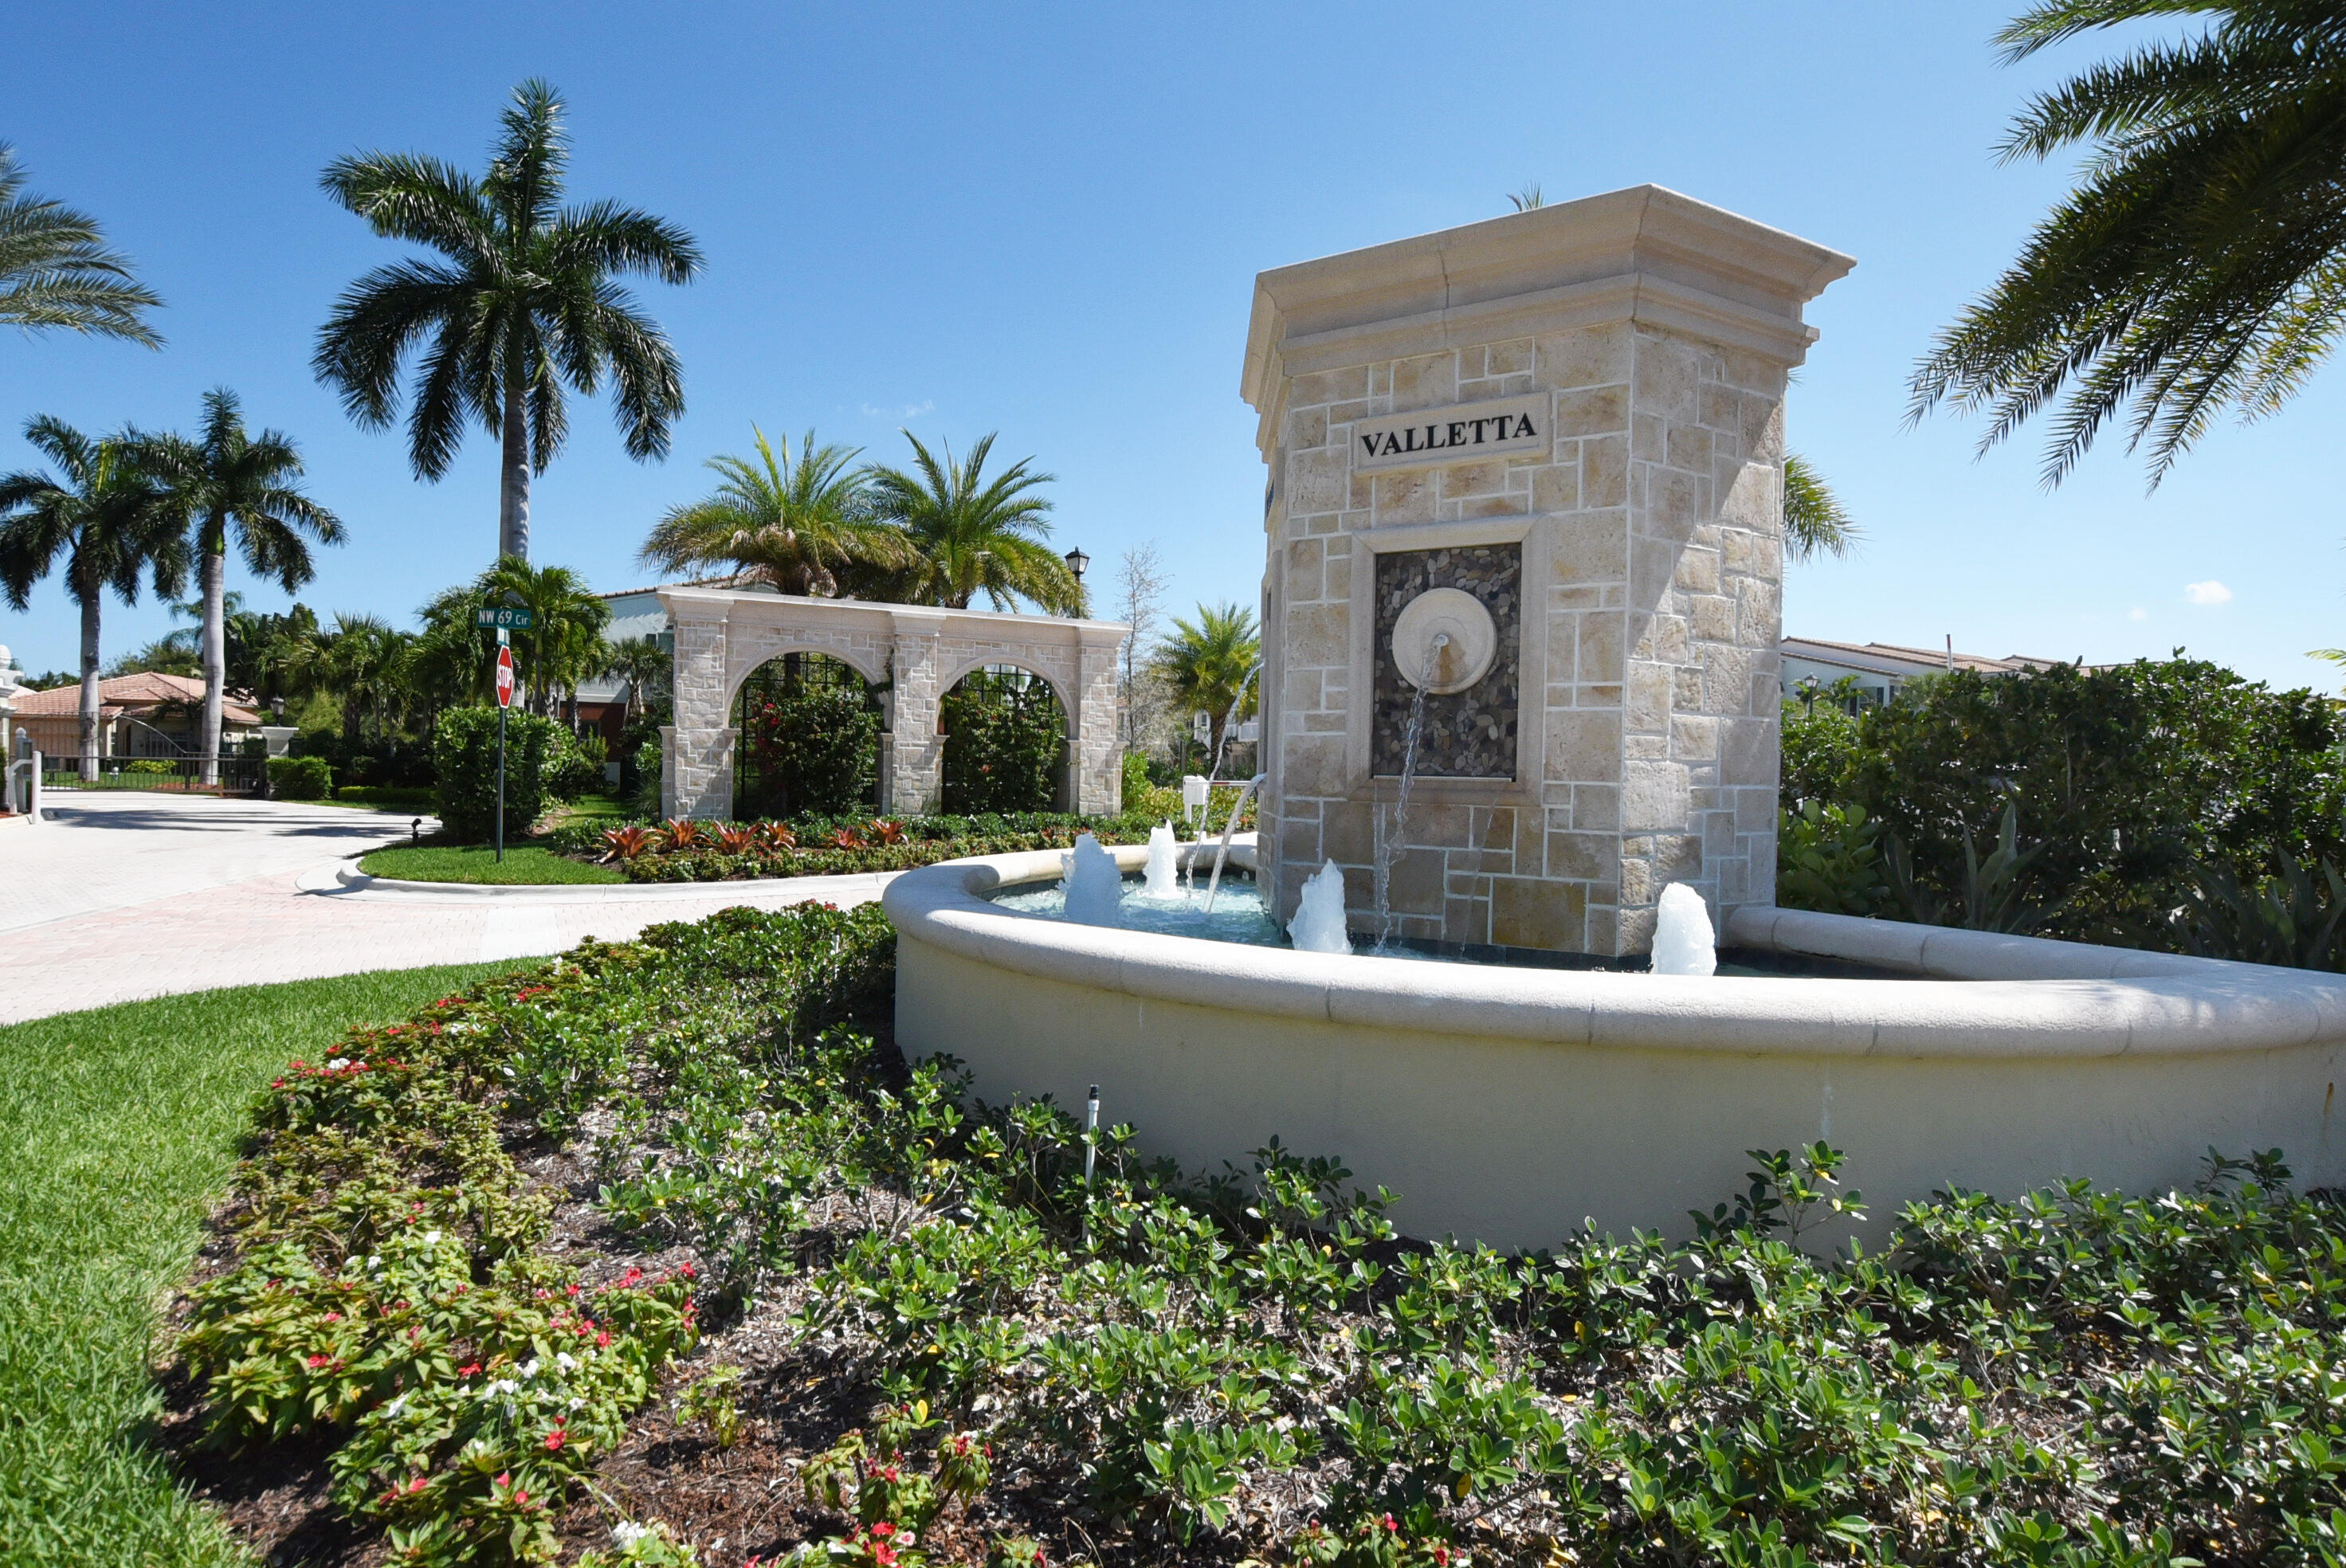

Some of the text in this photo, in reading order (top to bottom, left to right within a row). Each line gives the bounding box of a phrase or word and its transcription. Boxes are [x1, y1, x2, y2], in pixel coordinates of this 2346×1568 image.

[1361, 412, 1537, 457] VALLETTA
[479, 610, 529, 625] NW 69 Cir
[498, 664, 512, 689] STOP
